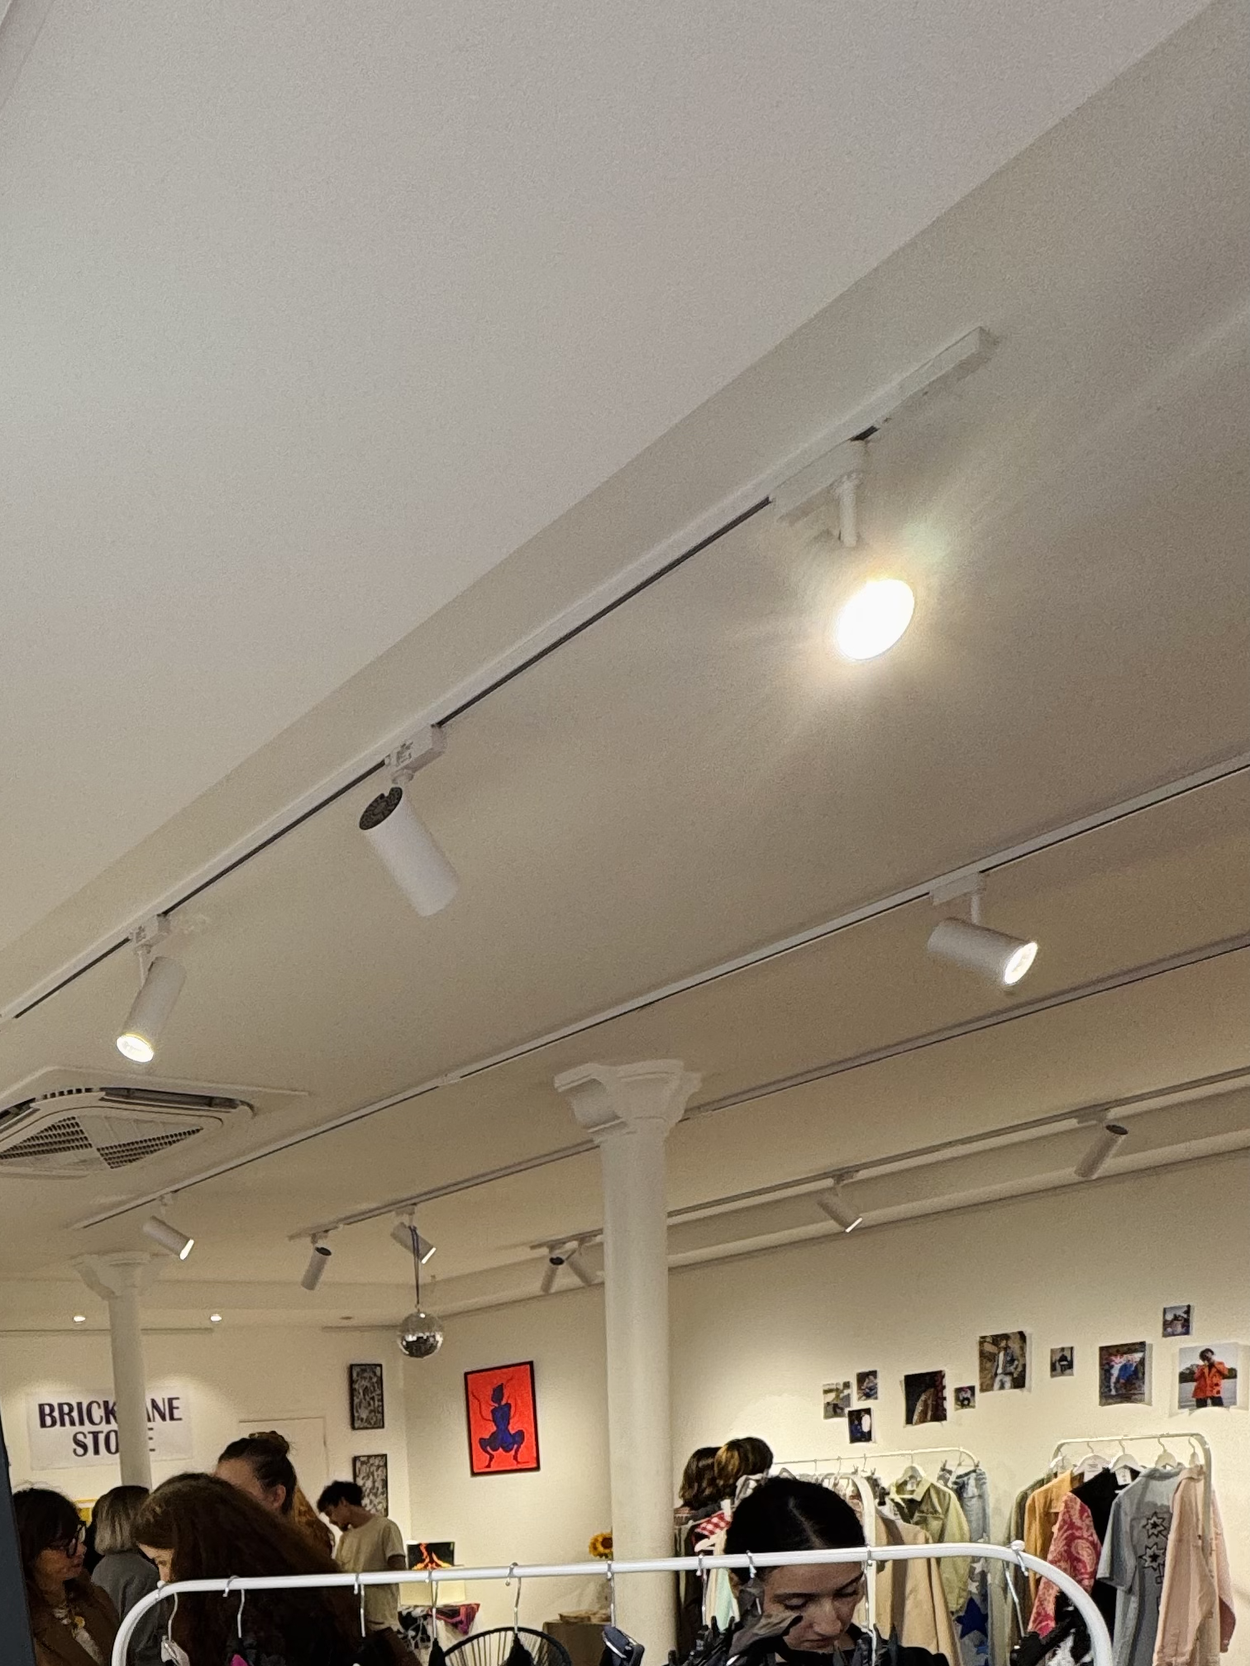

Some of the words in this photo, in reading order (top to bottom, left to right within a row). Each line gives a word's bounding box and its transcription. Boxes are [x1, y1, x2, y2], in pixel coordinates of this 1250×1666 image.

[38, 1400, 118, 1428] BRICK
[145, 1397, 183, 1422] NE
[72, 1427, 156, 1457] STO
